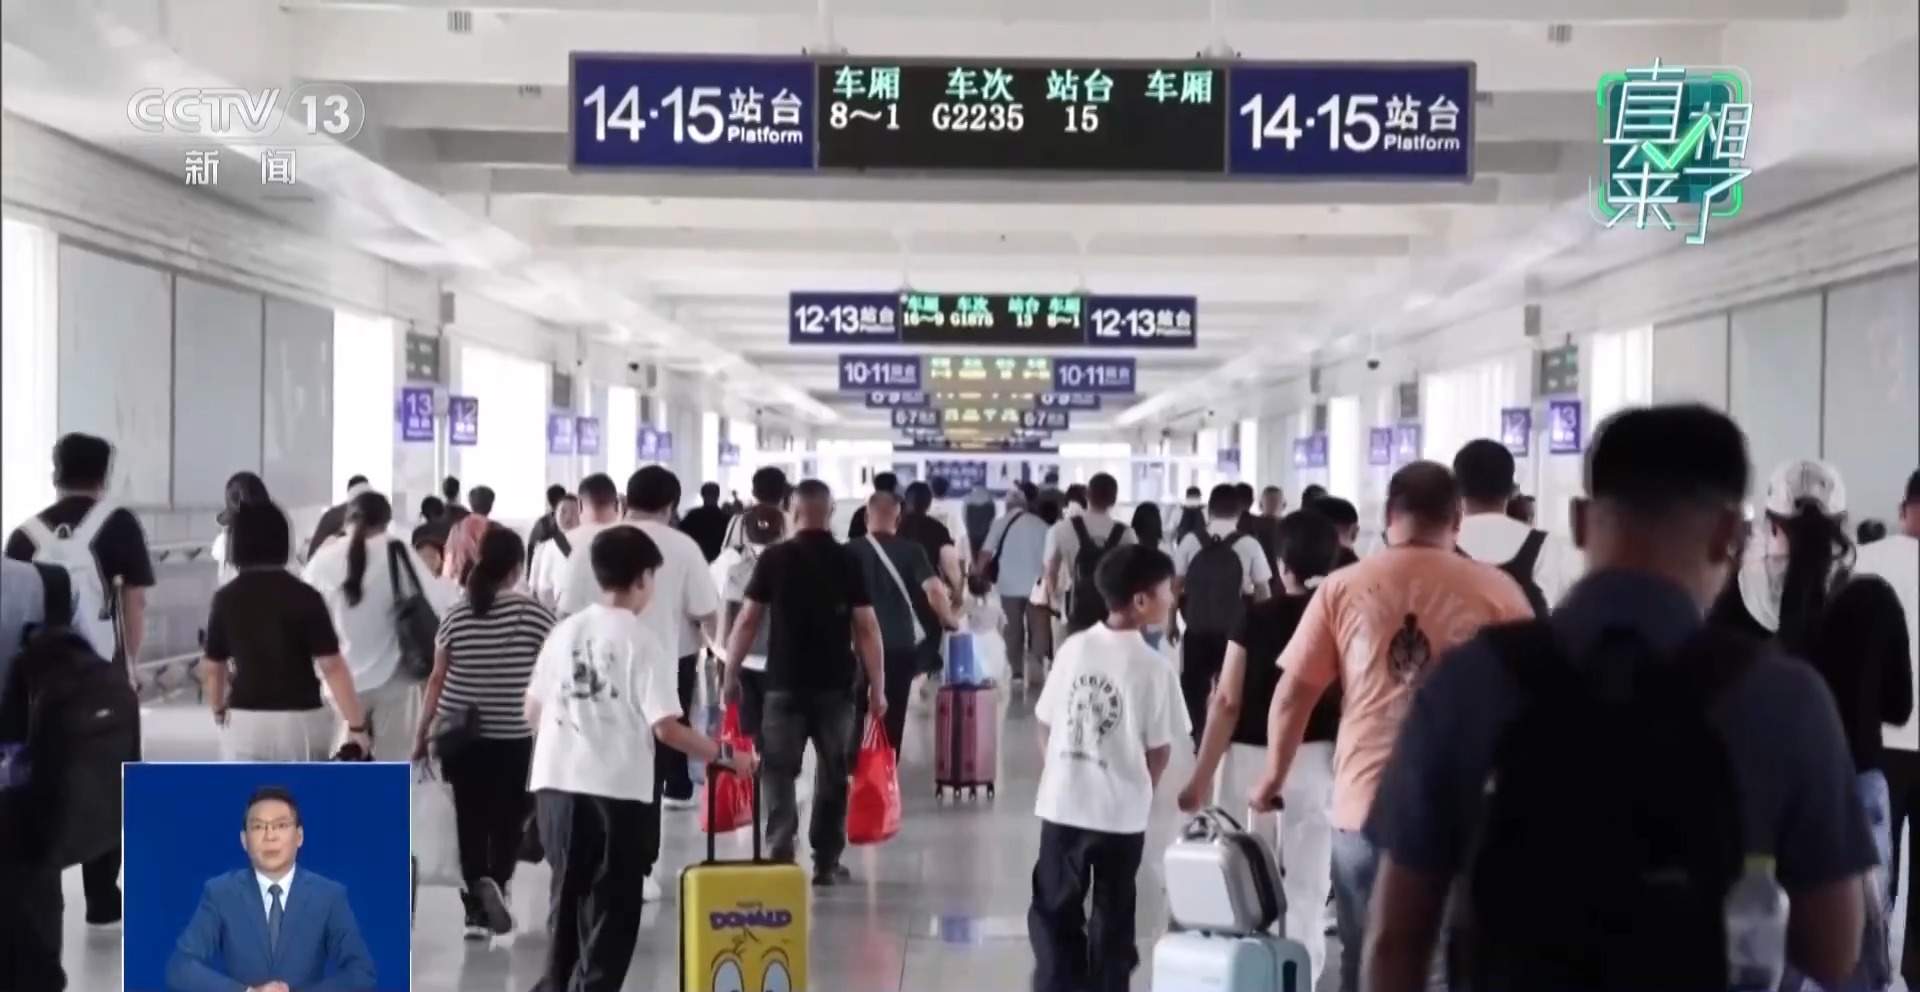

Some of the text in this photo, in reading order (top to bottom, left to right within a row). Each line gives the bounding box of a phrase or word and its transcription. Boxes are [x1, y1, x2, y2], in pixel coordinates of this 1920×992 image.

[833, 65, 1214, 104] 车厢 车次 站台 车厢
[728, 87, 803, 125] 站台
[932, 103, 1024, 131] G2235
[1064, 105, 1099, 132] 15
[1385, 94, 1460, 131] 站台
[728, 128, 803, 144] Platform
[1383, 134, 1461, 151] Platform
[406, 393, 433, 416] 13
[709, 909, 792, 931] DONALD
